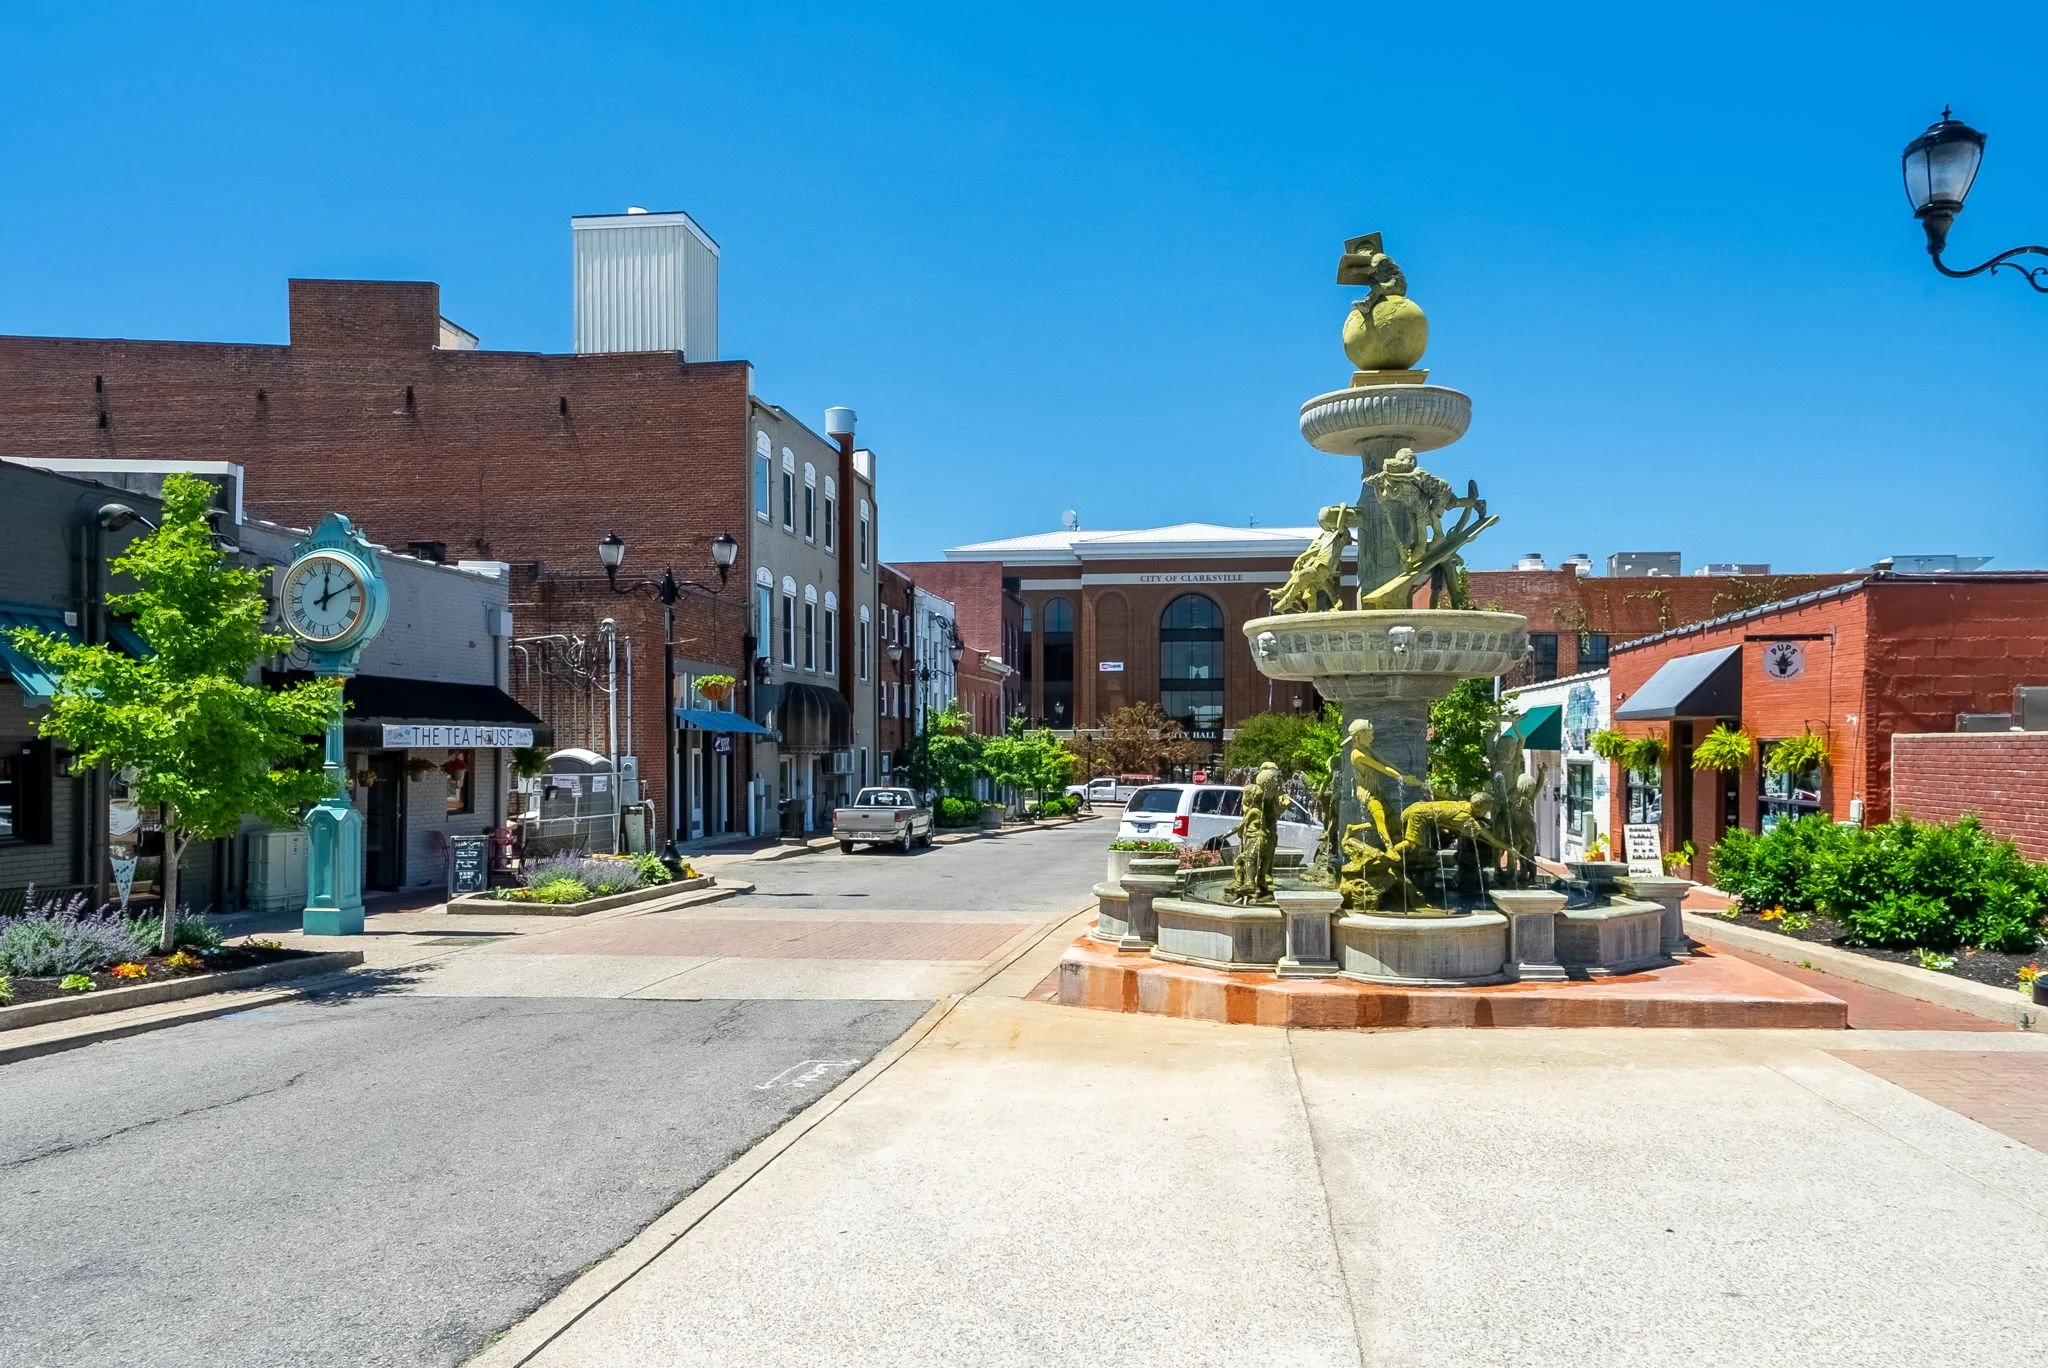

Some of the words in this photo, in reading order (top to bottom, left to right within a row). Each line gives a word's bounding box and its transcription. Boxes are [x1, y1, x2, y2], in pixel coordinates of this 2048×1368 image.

[1139, 575, 1162, 583] CITY
[1165, 575, 1177, 583] OF
[1181, 574, 1243, 582] CLARKSVILLE
[1770, 644, 1798, 656] PUPS
[412, 727, 440, 746] THE
[445, 727, 471, 746] TEA
[1193, 731, 1216, 739] HALL
